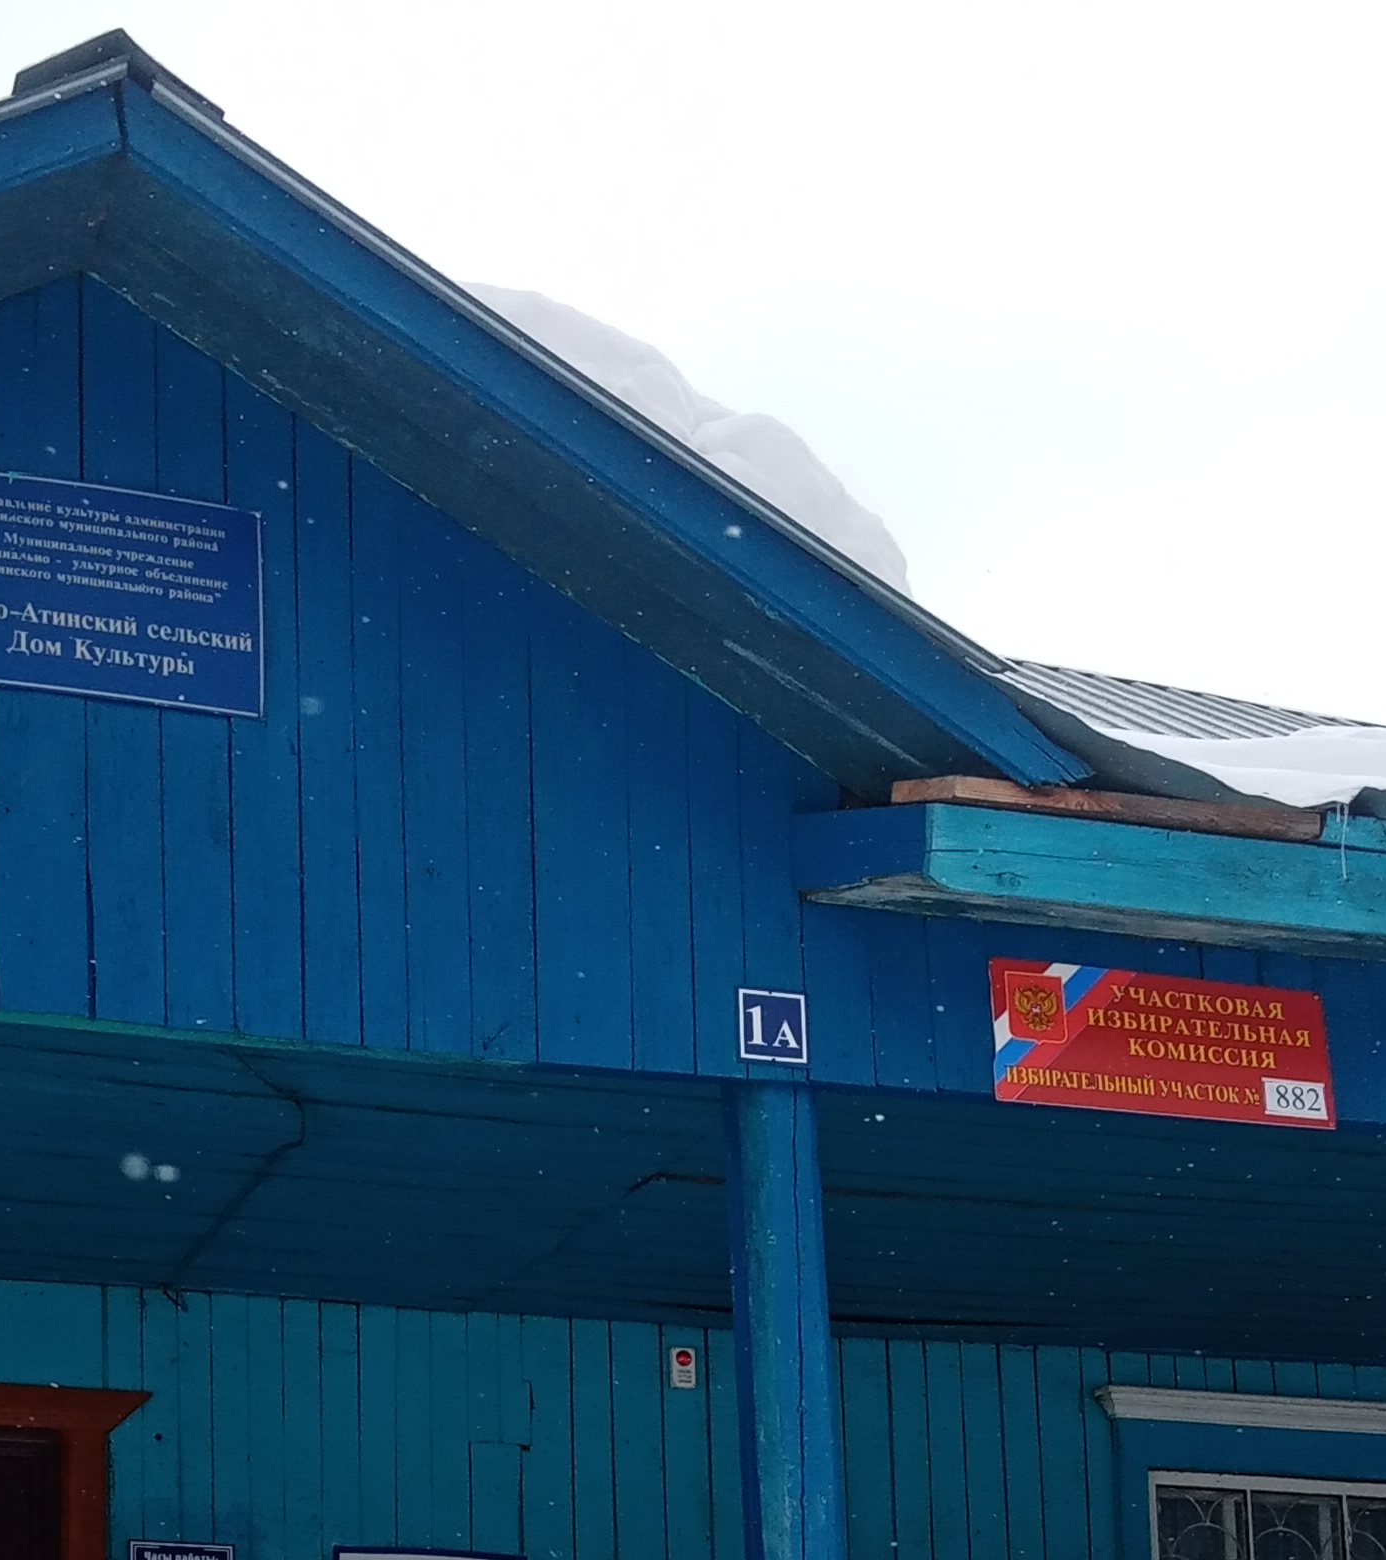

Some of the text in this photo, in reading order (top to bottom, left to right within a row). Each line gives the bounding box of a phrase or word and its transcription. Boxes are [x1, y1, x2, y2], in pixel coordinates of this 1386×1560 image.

[56, 504, 120, 522] культуры
[125, 514, 225, 539] администрации
[58, 520, 168, 544] муниципального
[173, 536, 219, 552] района
[3, 531, 194, 569] Муниципальное учреждение
[56, 572, 163, 596] муниципального
[145, 568, 228, 590] объединение
[6, 629, 195, 675] Дом Культуры
[147, 622, 252, 652] сельский
[1110, 985, 1285, 1020] УЧАСТКОВАЯ
[1087, 1008, 1311, 1047] ИЗБИРАТЕЛЬНАЯ
[1128, 1037, 1277, 1069] КОМИССИЯ
[1006, 1066, 1321, 1112] ИЗБИРАТЕЛЬНЫЙ УЧАСТОК № 882
